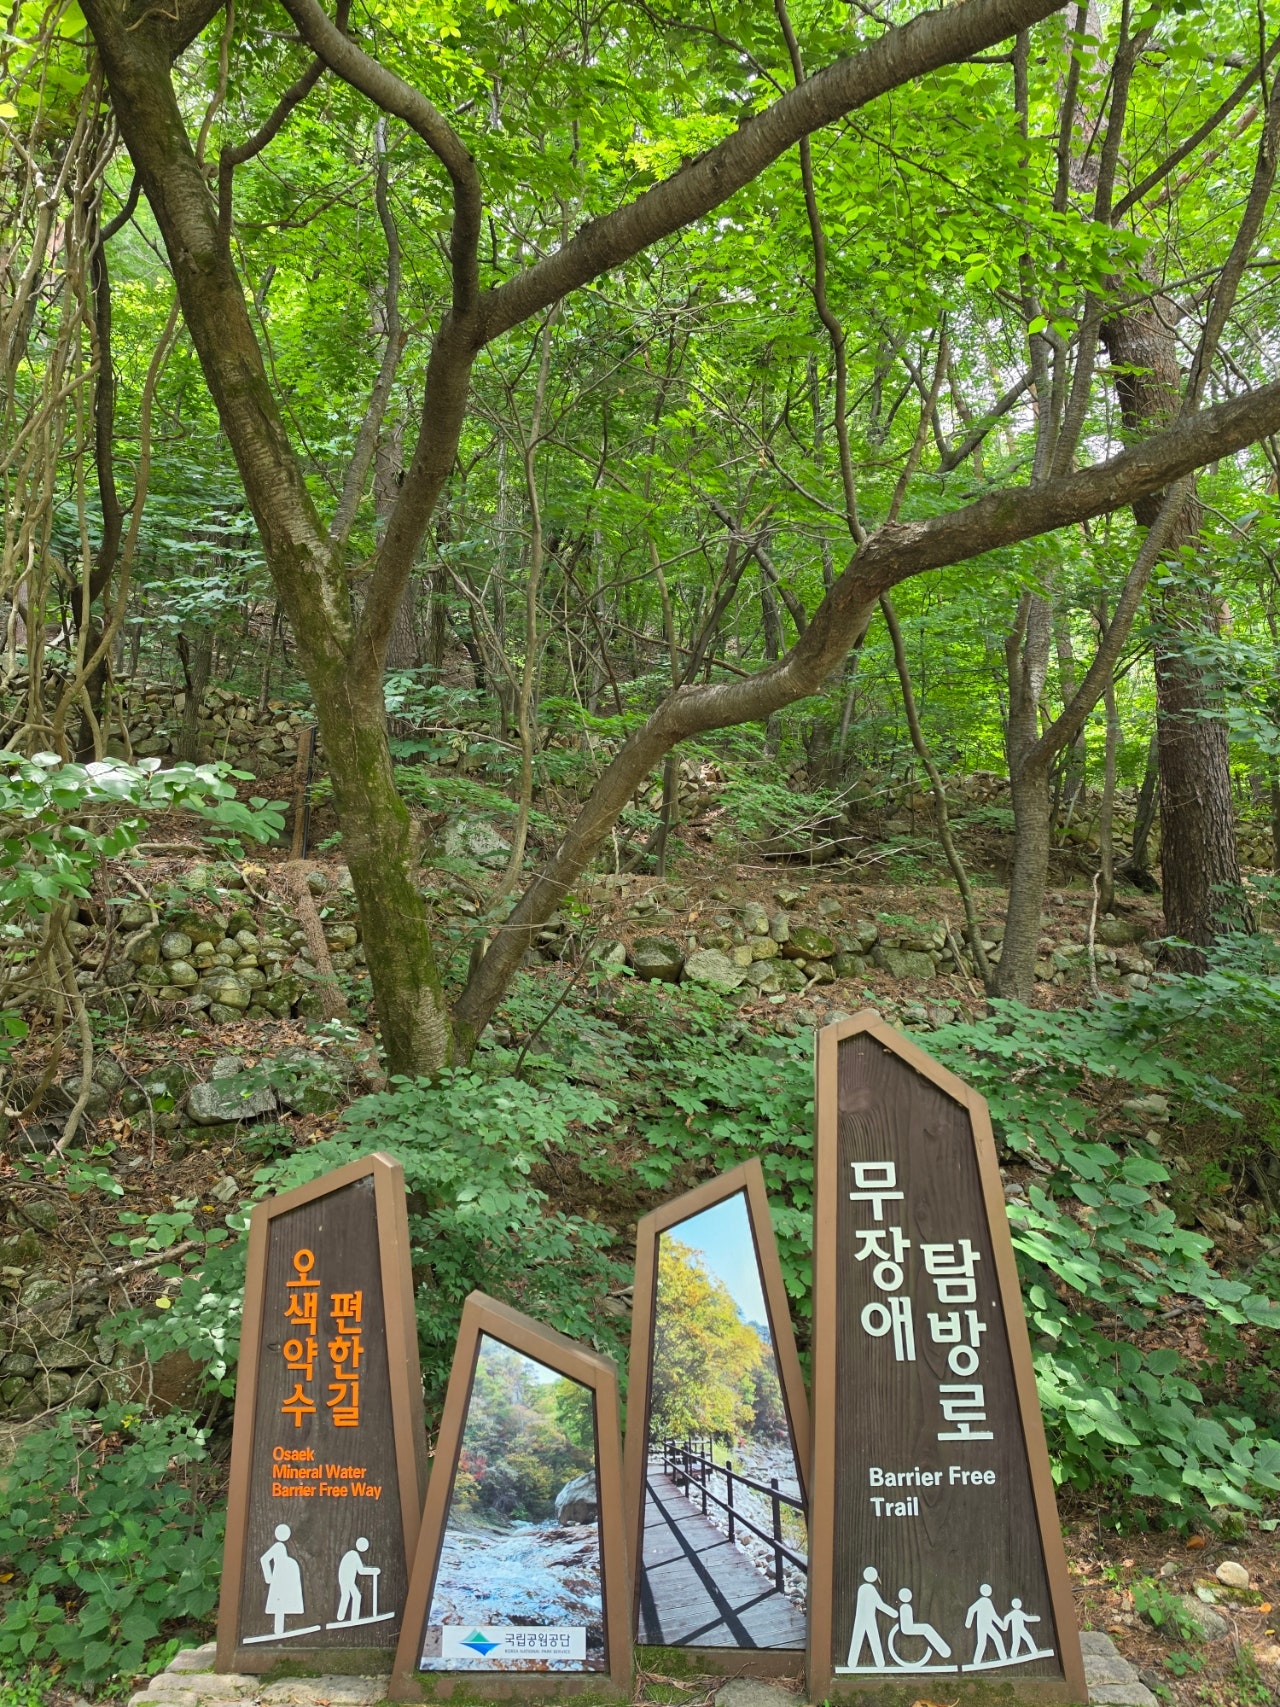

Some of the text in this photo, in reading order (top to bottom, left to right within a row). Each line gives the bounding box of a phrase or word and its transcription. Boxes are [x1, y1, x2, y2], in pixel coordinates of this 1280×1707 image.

[849, 1161, 917, 1362] 무장애
[281, 1248, 321, 1427] 오색약수
[919, 1239, 995, 1441] 탐방로
[326, 1290, 365, 1428] 편한길
[272, 1446, 315, 1462] Osaek
[272, 1464, 367, 1480] Mineral Water
[869, 1465, 996, 1487] Barrier Free
[271, 1481, 382, 1501] Barrier Free Way
[870, 1497, 920, 1517] Trail
[505, 1633, 570, 1647] 국립공원공단
